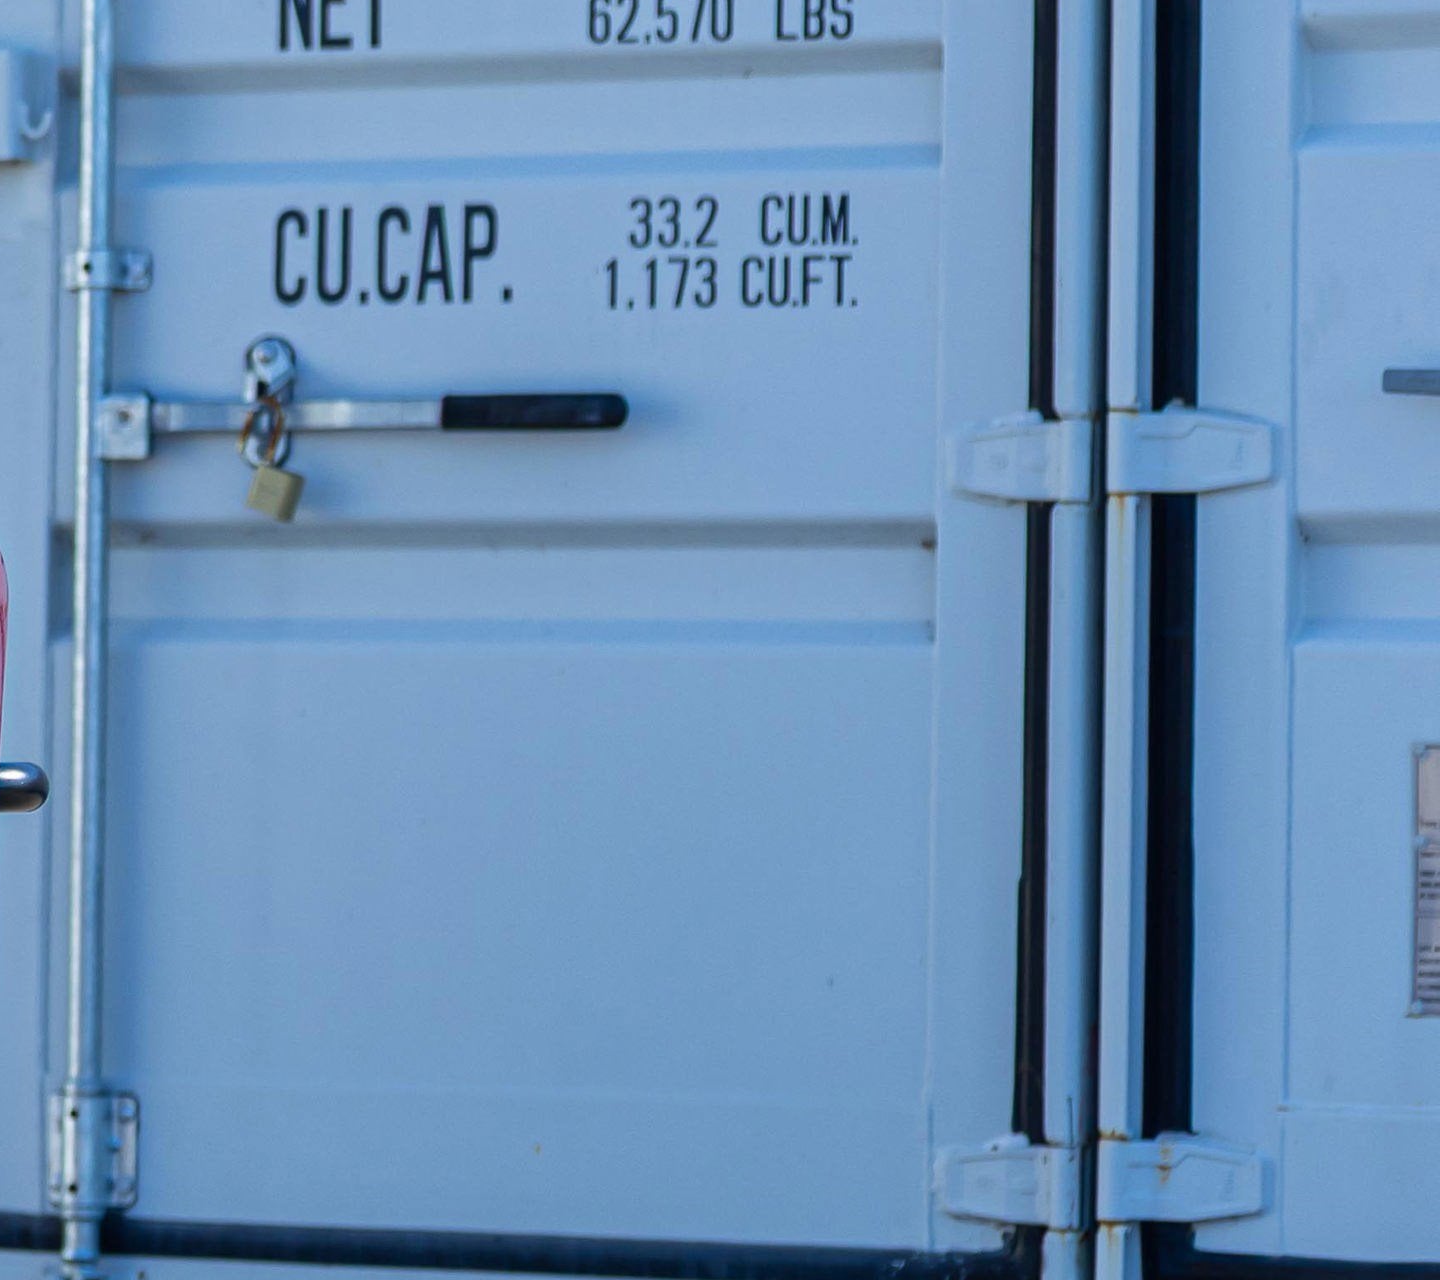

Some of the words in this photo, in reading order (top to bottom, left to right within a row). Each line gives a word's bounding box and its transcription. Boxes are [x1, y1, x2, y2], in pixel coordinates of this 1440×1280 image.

[274, 204, 512, 306] CU.CAP.
[629, 197, 718, 249] 33.2
[760, 192, 859, 246] CU.M.
[741, 254, 858, 308] CU.FT.
